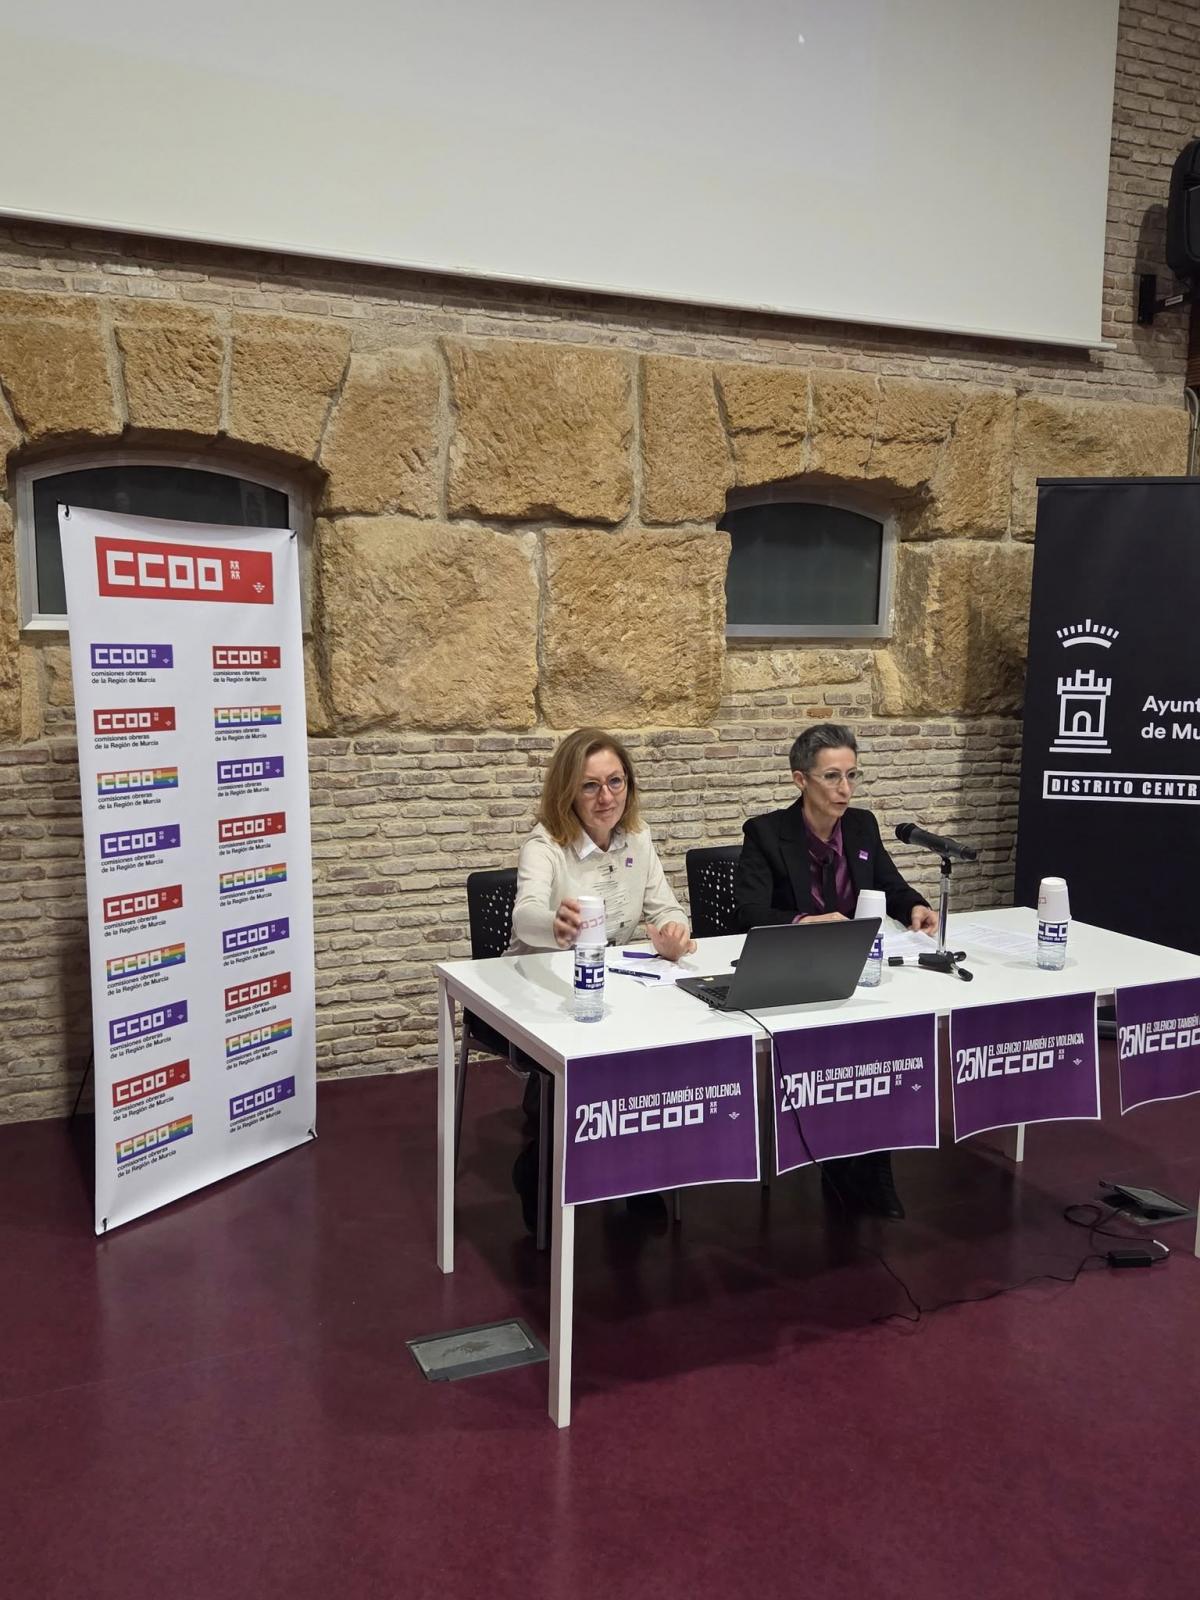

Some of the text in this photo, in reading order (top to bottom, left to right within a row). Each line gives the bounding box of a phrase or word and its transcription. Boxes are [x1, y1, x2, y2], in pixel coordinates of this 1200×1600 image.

[106, 550, 224, 590] CCOO
[95, 649, 148, 663] CCOO
[216, 651, 260, 664] CCOO
[218, 708, 261, 722] CCOO
[1142, 696, 1200, 716] Ayunt
[98, 713, 151, 729] CCOO
[1141, 722, 1200, 740] de Mu
[102, 771, 153, 789] CCOO
[221, 762, 264, 778] CCOO
[1052, 778, 1198, 796] DISTRITO CENTR
[222, 819, 265, 837] CCOO
[105, 832, 156, 853] CCOO
[101, 857, 132, 865] comisiones
[223, 869, 266, 888] CCOO
[108, 893, 158, 917] CCOO
[104, 920, 134, 929] comisiones
[226, 926, 269, 947] CCOO
[111, 950, 161, 976] CCOO
[107, 972, 160, 988] comisiones obreras
[122, 983, 142, 992] Región
[228, 982, 271, 1004] CCOO
[114, 1012, 164, 1038] CCOO
[1146, 1022, 1152, 1033] EL
[1153, 1018, 1176, 1032] SILENCIO
[110, 1033, 162, 1051] comisiones obreras
[125, 1045, 144, 1054] Región
[153, 1037, 170, 1045] Murcia
[230, 1027, 272, 1051] CCOO
[988, 1033, 1084, 1056] EL SILENCIO TAMBIÉN ES VIOLENCIA
[1119, 1023, 1146, 1060] 25N
[1146, 1028, 1200, 1053] CCOO
[817, 1057, 924, 1082] EL SILENCIO TAMBIÉN ES VIOLENCIA
[956, 1046, 988, 1084] 25N
[988, 1050, 1054, 1077] CCOO
[117, 1072, 166, 1101] CCOO
[618, 1082, 742, 1112] EL SILENCIO TAMBIÉN ES VIOLENCIA
[780, 1070, 816, 1112] 25N
[817, 1076, 890, 1104] CCOO
[113, 1093, 164, 1114] comisiones obreras
[128, 1106, 147, 1116] Región
[156, 1096, 173, 1106] Murcia
[233, 1088, 275, 1114] CCOO
[575, 1100, 616, 1143] 25N
[619, 1102, 704, 1135] CCOO
[120, 1126, 169, 1157] CCOO
[117, 1147, 168, 1170] comisiones obreras
[132, 1161, 150, 1172] Región
[159, 1150, 176, 1160] Murcia
